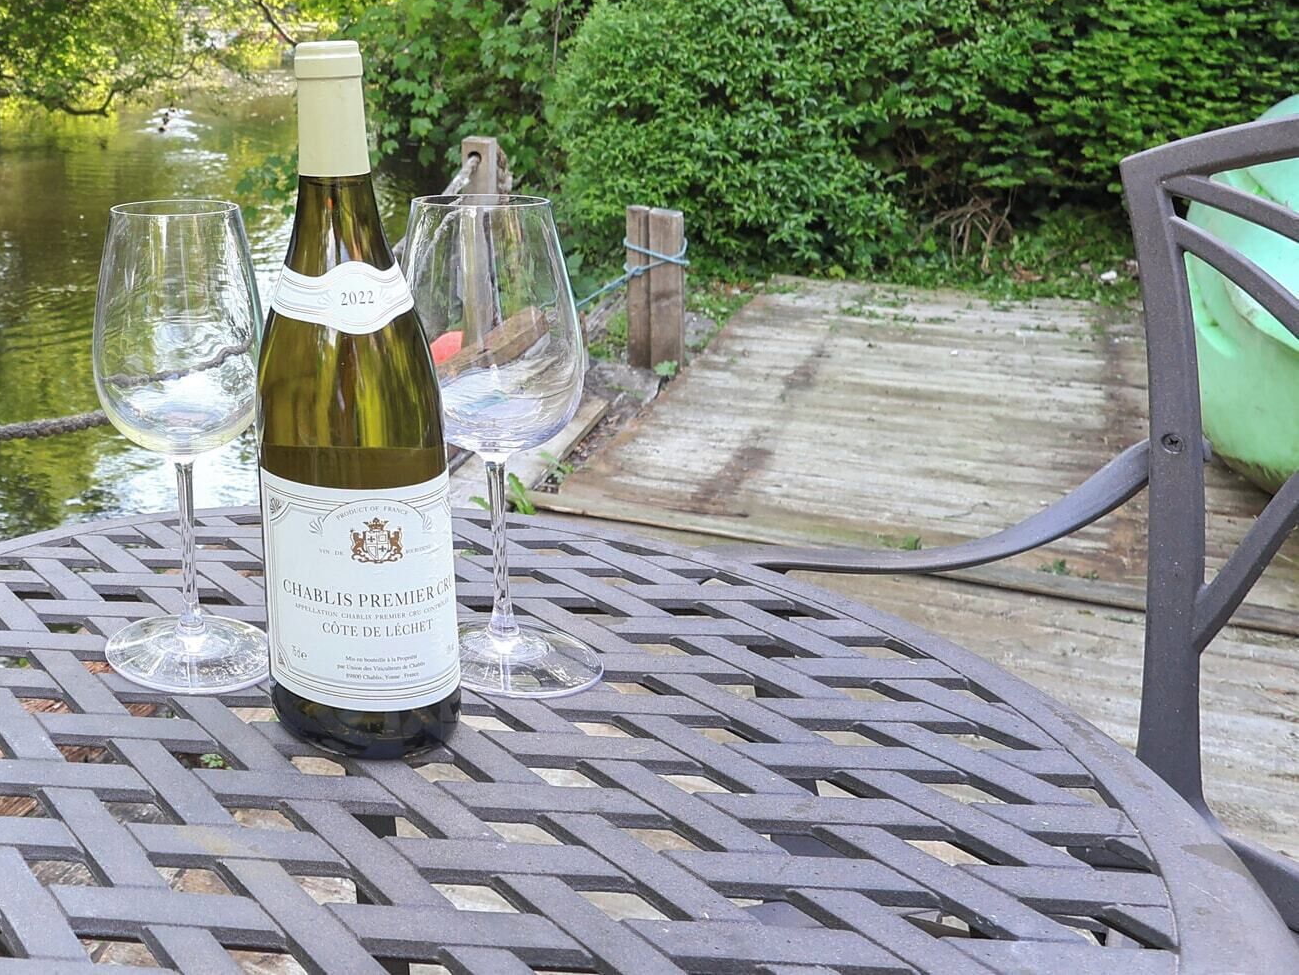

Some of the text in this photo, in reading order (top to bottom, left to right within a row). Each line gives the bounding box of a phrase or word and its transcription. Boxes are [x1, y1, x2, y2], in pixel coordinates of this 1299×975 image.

[340, 290, 374, 306] 2022
[336, 506, 369, 521] PRODUCT
[383, 506, 408, 515] FRANCE
[283, 579, 353, 607] CHABLIS
[359, 586, 434, 608] PREMIER
[294, 603, 339, 618] APPELLATION
[341, 613, 372, 621] CHABLIS
[375, 612, 407, 620] PREMIER
[408, 609, 422, 617] CRU
[322, 618, 433, 638] CÔTE DE LÉCHET
